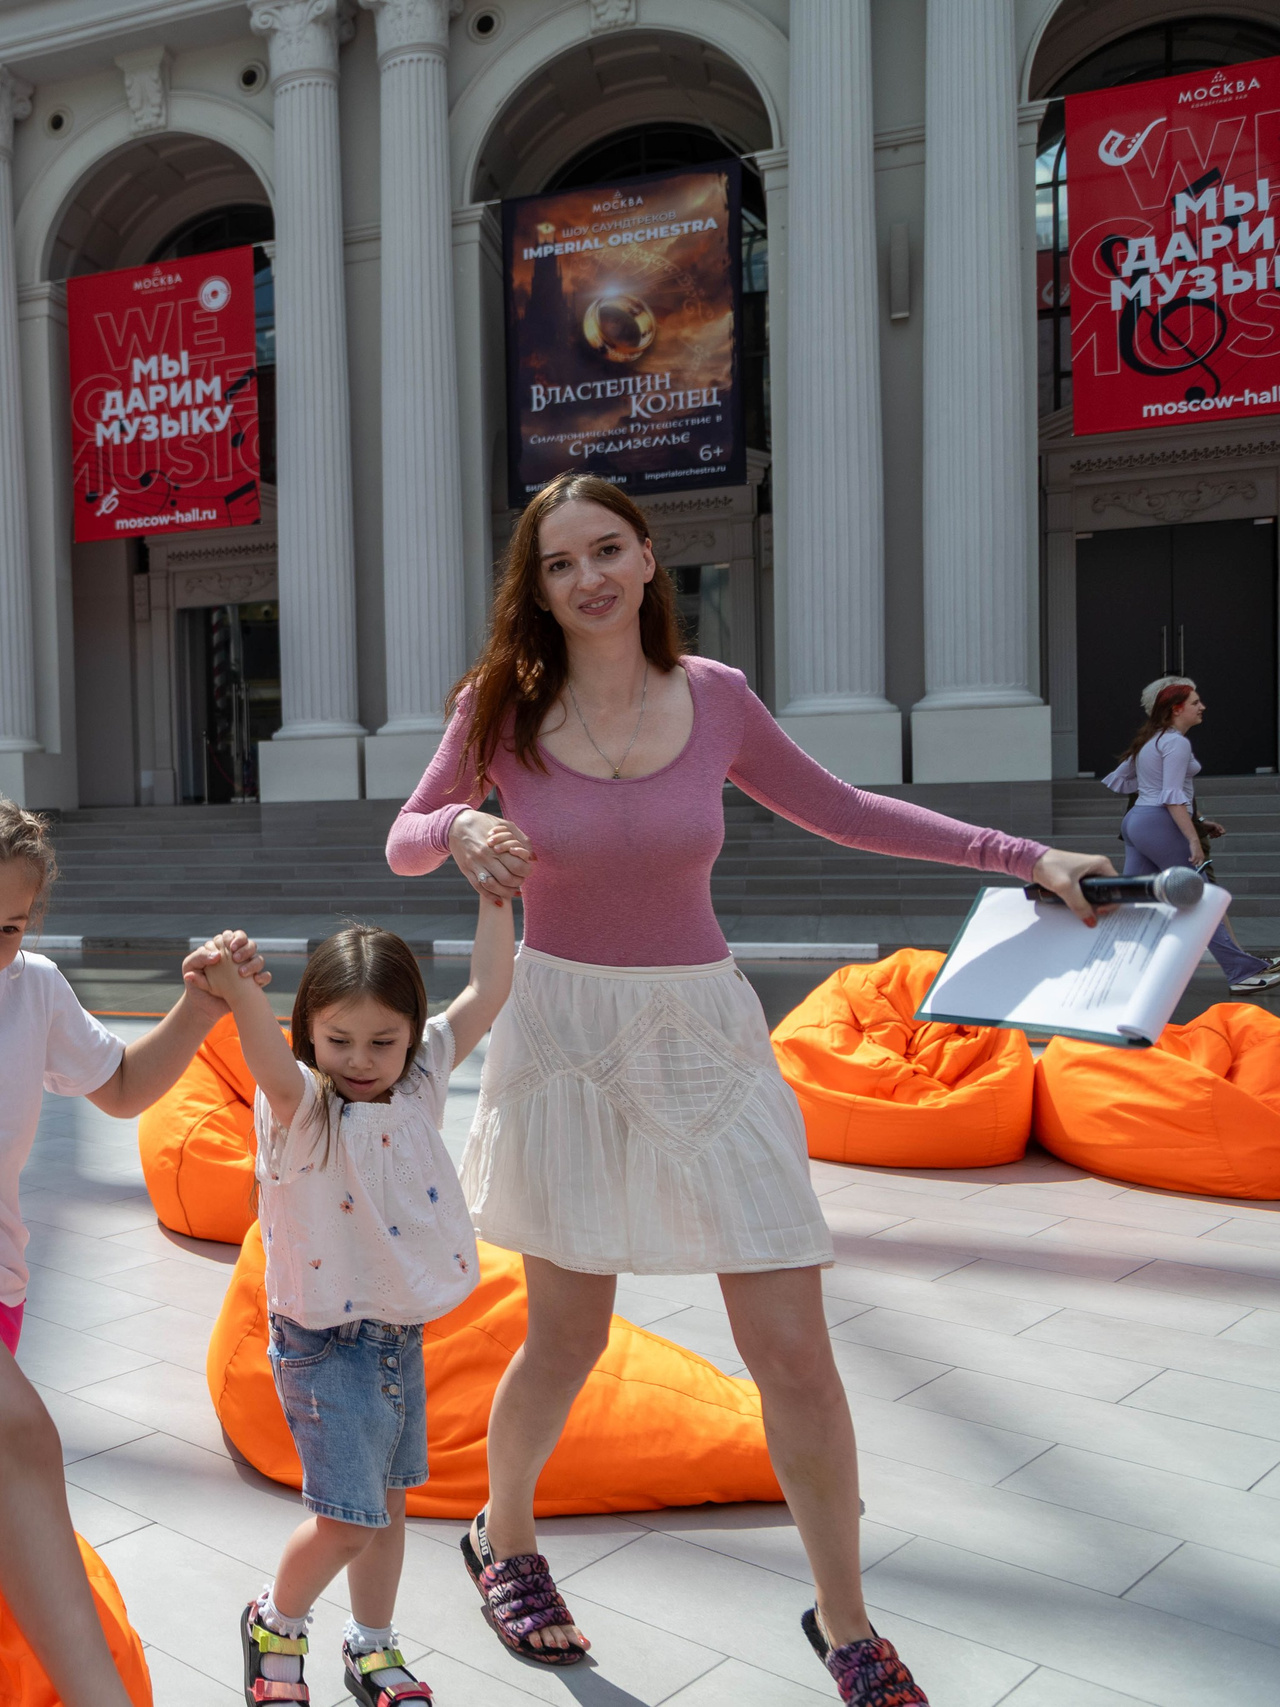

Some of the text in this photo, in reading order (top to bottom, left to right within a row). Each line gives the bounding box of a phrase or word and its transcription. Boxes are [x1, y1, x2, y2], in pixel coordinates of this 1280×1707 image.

[1177, 77, 1261, 104] МОСКВА
[592, 195, 644, 213] МОСКВА
[1175, 178, 1270, 225] МЫ
[523, 217, 719, 261] IMPERIAL ORCHESTRA
[562, 225, 590, 238] ШОУ
[592, 210, 677, 233] САУНДТРЕКОВ
[133, 273, 183, 291] МОСКВА
[1110, 255, 1280, 311] МУЗЫ
[133, 350, 190, 383] МЫ
[101, 376, 222, 422] ДАРИМ
[630, 386, 722, 419] КОЛЕЦ
[95, 404, 234, 447] МУЗЫКУ
[699, 444, 724, 462] 6+
[115, 507, 217, 531] moscow-hall.ru
